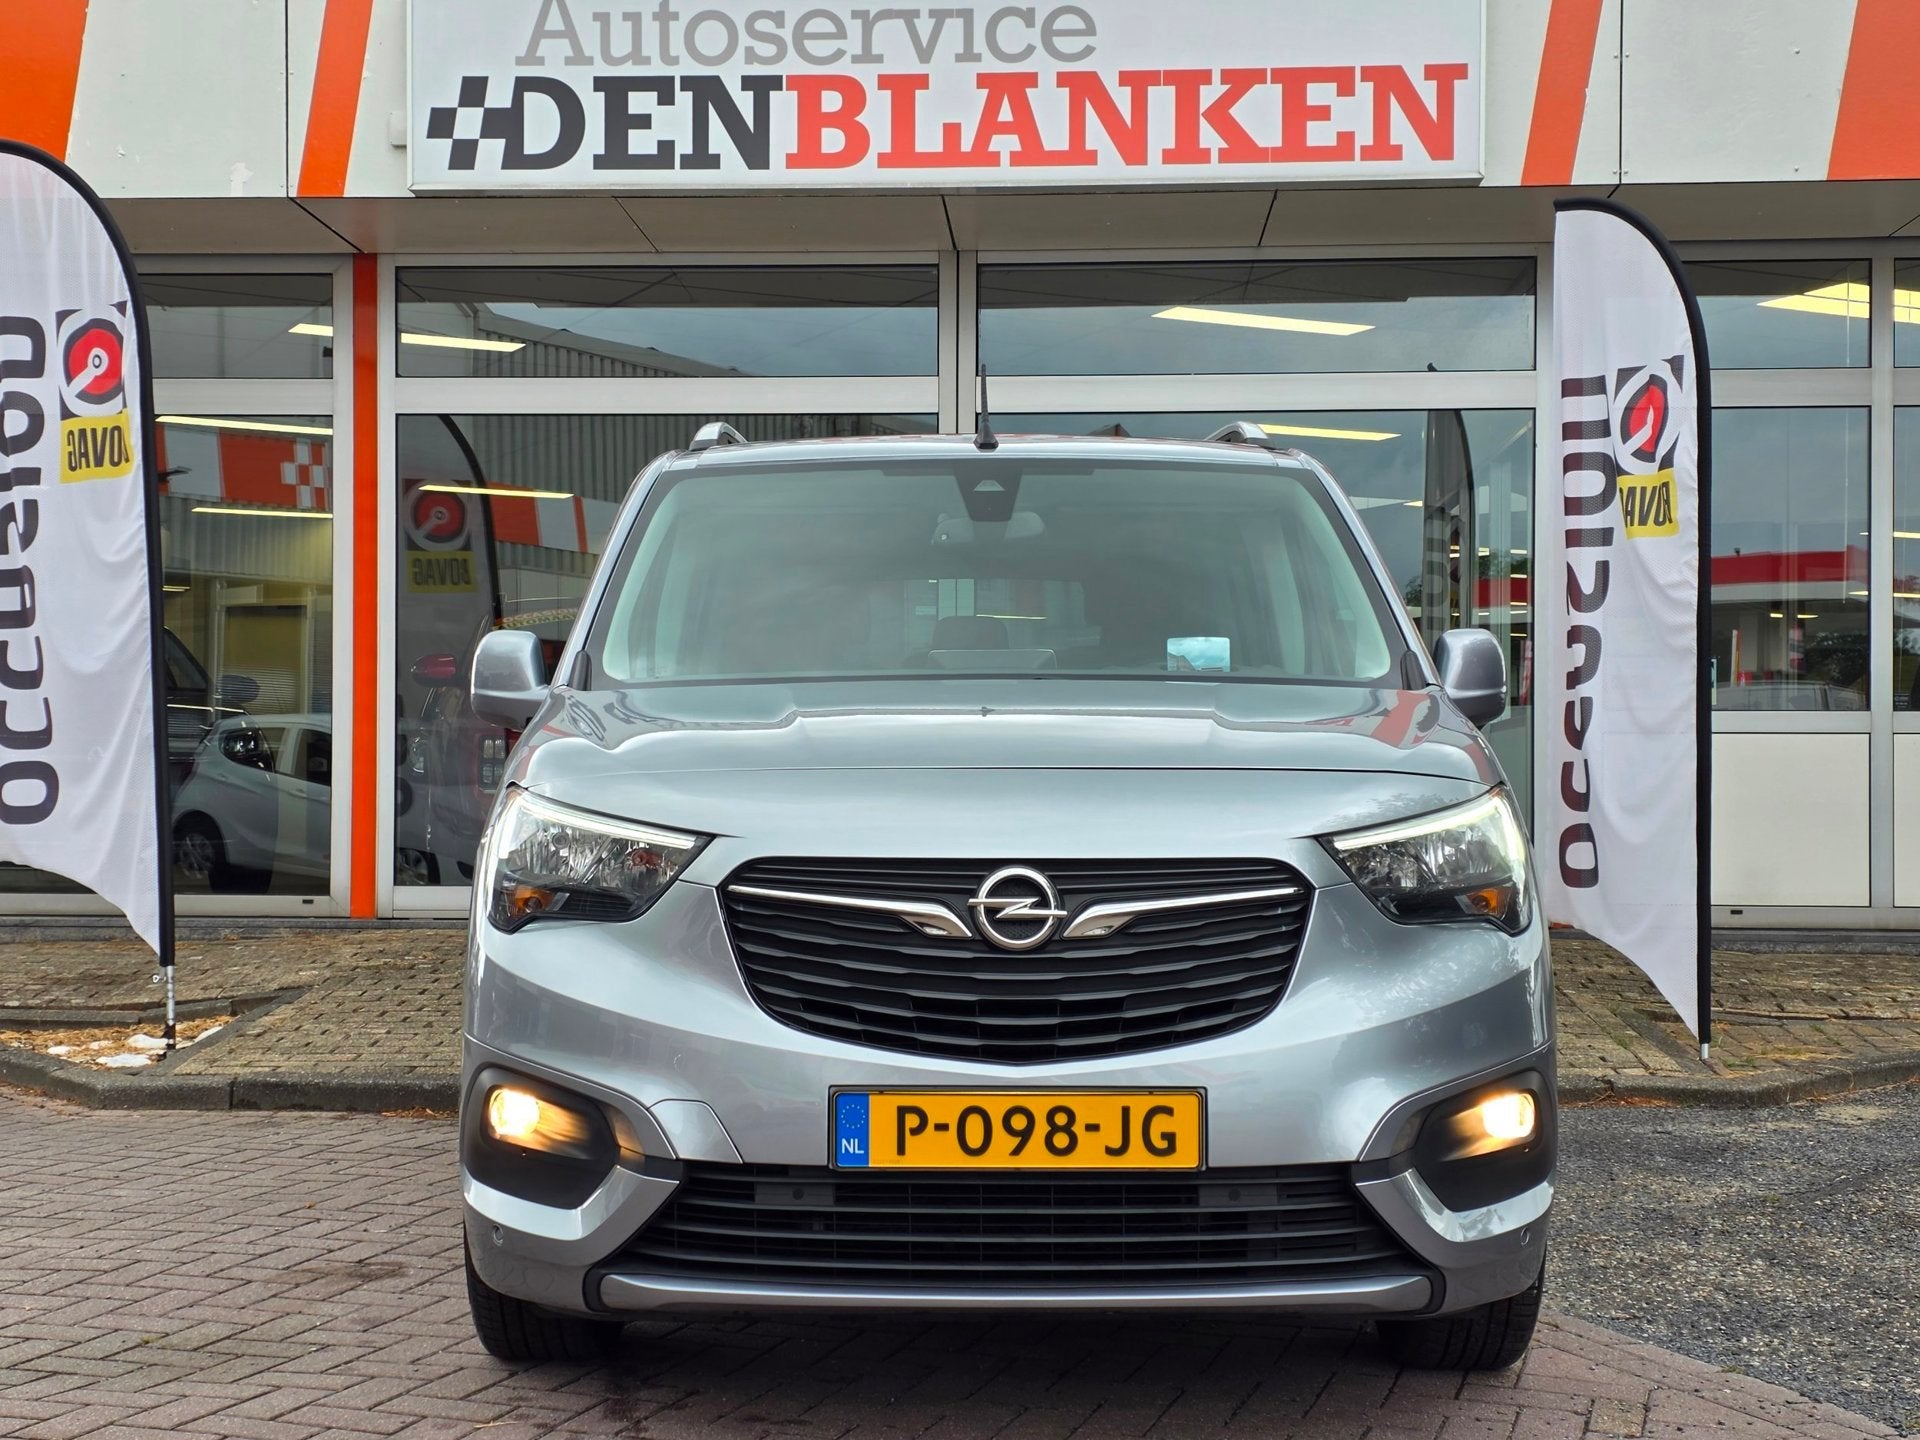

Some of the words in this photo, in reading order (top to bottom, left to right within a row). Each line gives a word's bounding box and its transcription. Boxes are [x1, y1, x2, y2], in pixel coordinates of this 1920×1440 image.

[514, 0, 1098, 66] Autoservice
[841, 1138, 865, 1154] NL
[896, 1105, 1177, 1156] P-098-JG
